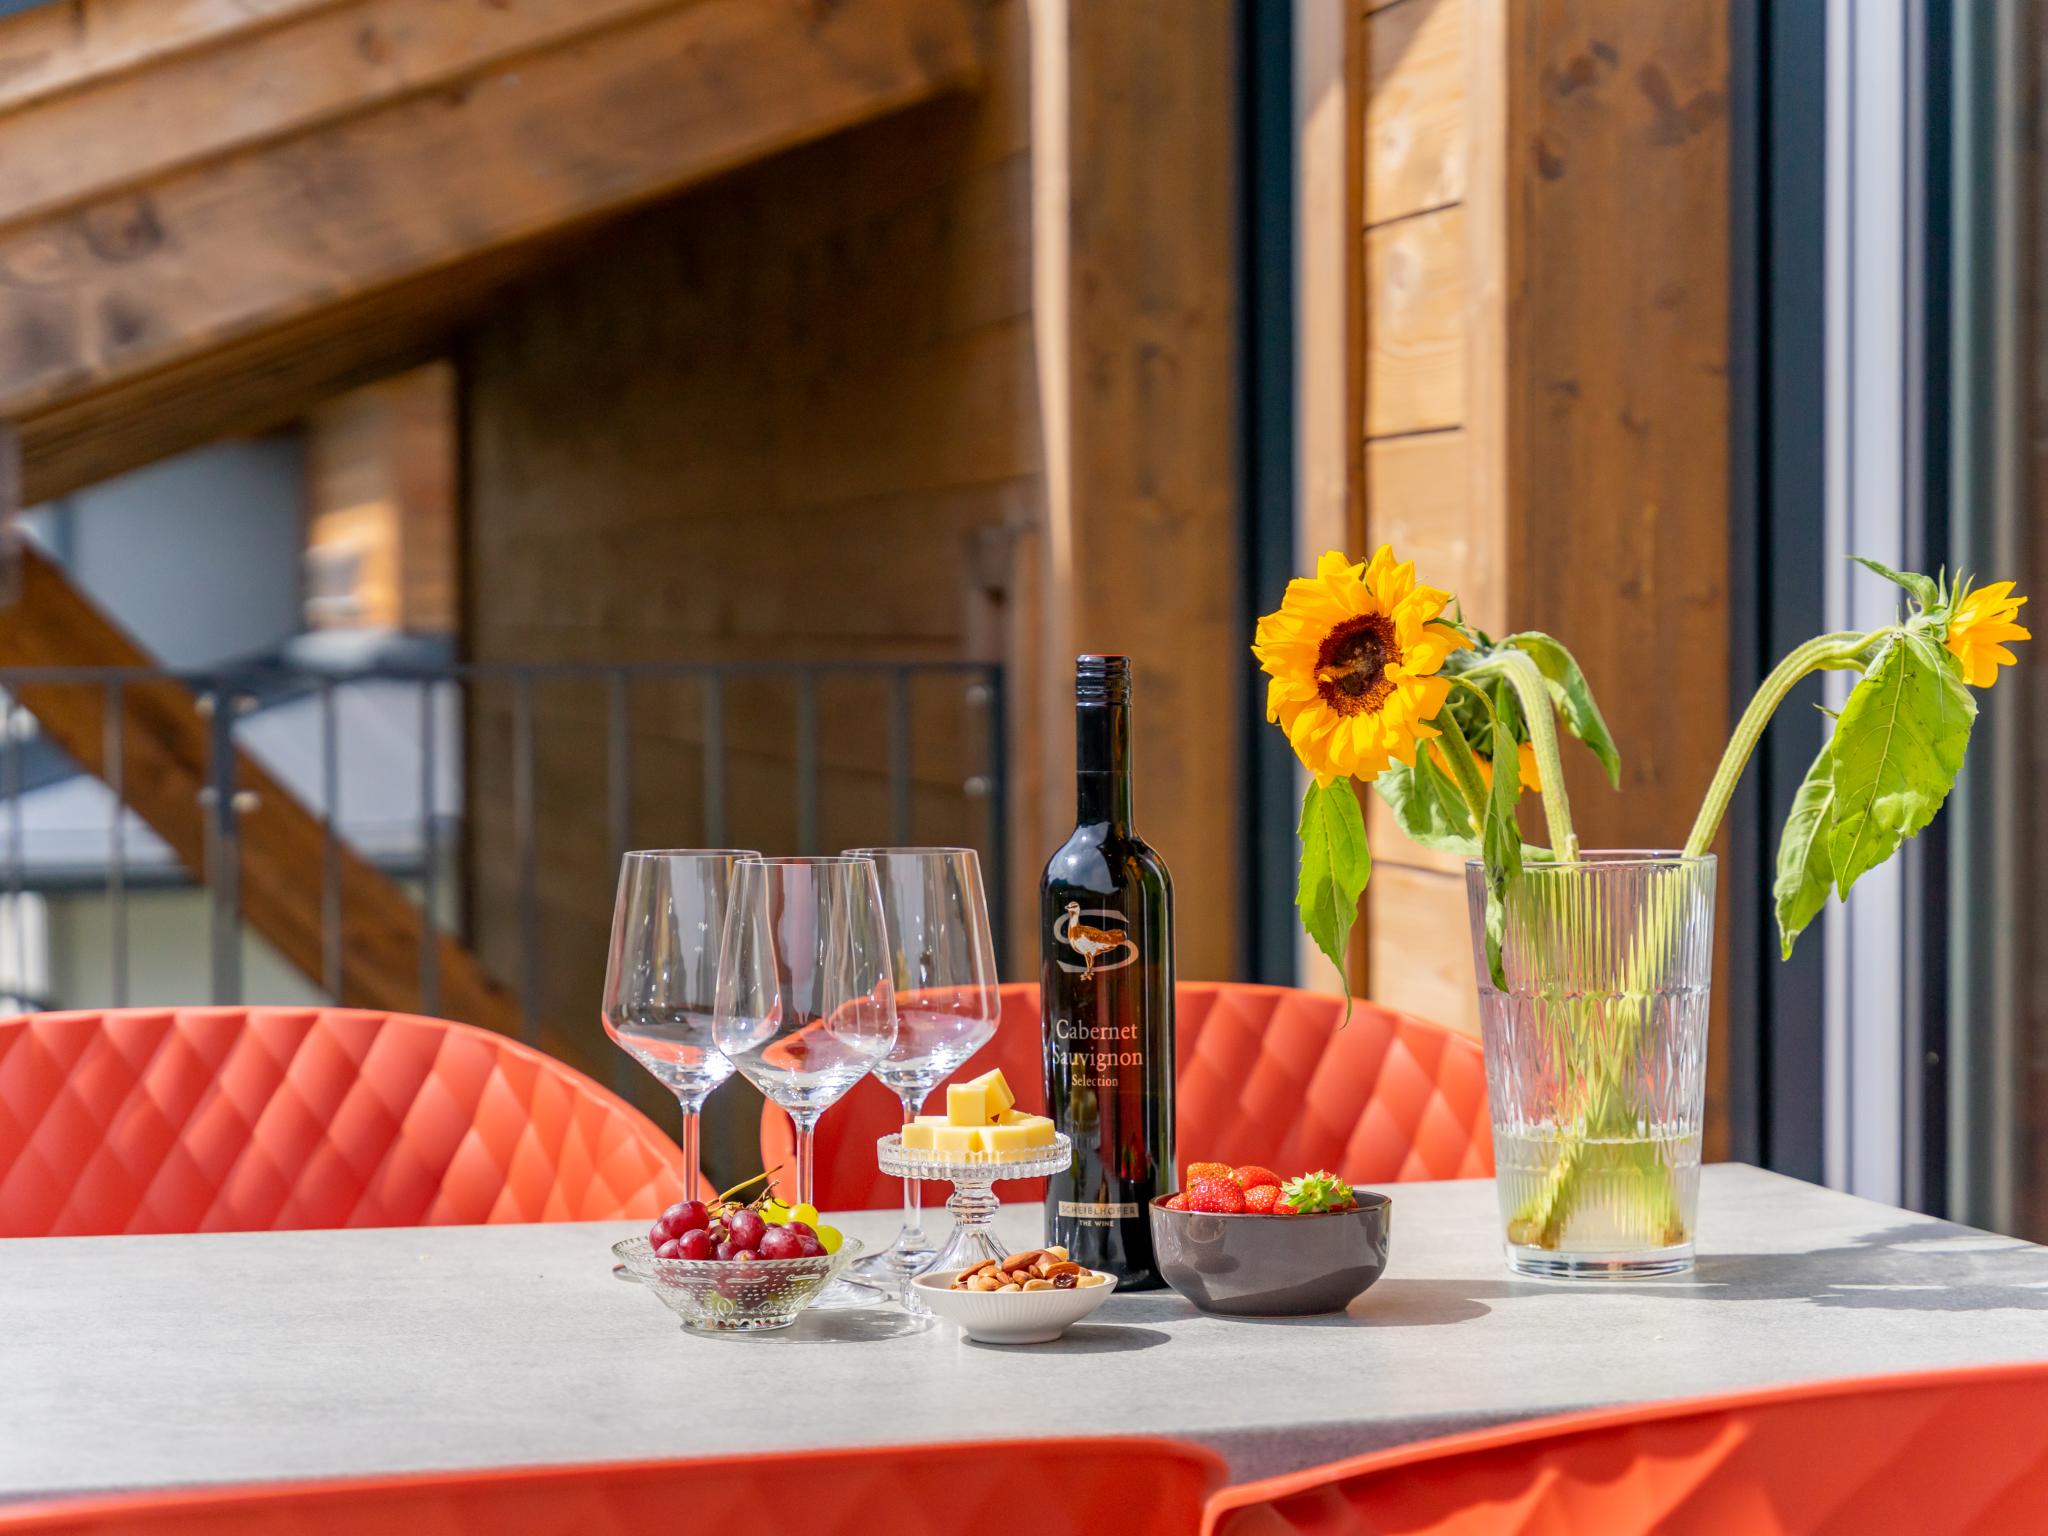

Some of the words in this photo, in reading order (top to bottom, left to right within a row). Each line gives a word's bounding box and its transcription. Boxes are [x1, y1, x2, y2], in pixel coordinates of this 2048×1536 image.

[1053, 909, 1139, 973] S
[1056, 1019, 1138, 1040] Cabernet
[1052, 1045, 1143, 1072] Sauvignon
[1071, 1074, 1119, 1087] Selection
[1061, 1205, 1135, 1217] SCHEIBLHOFER
